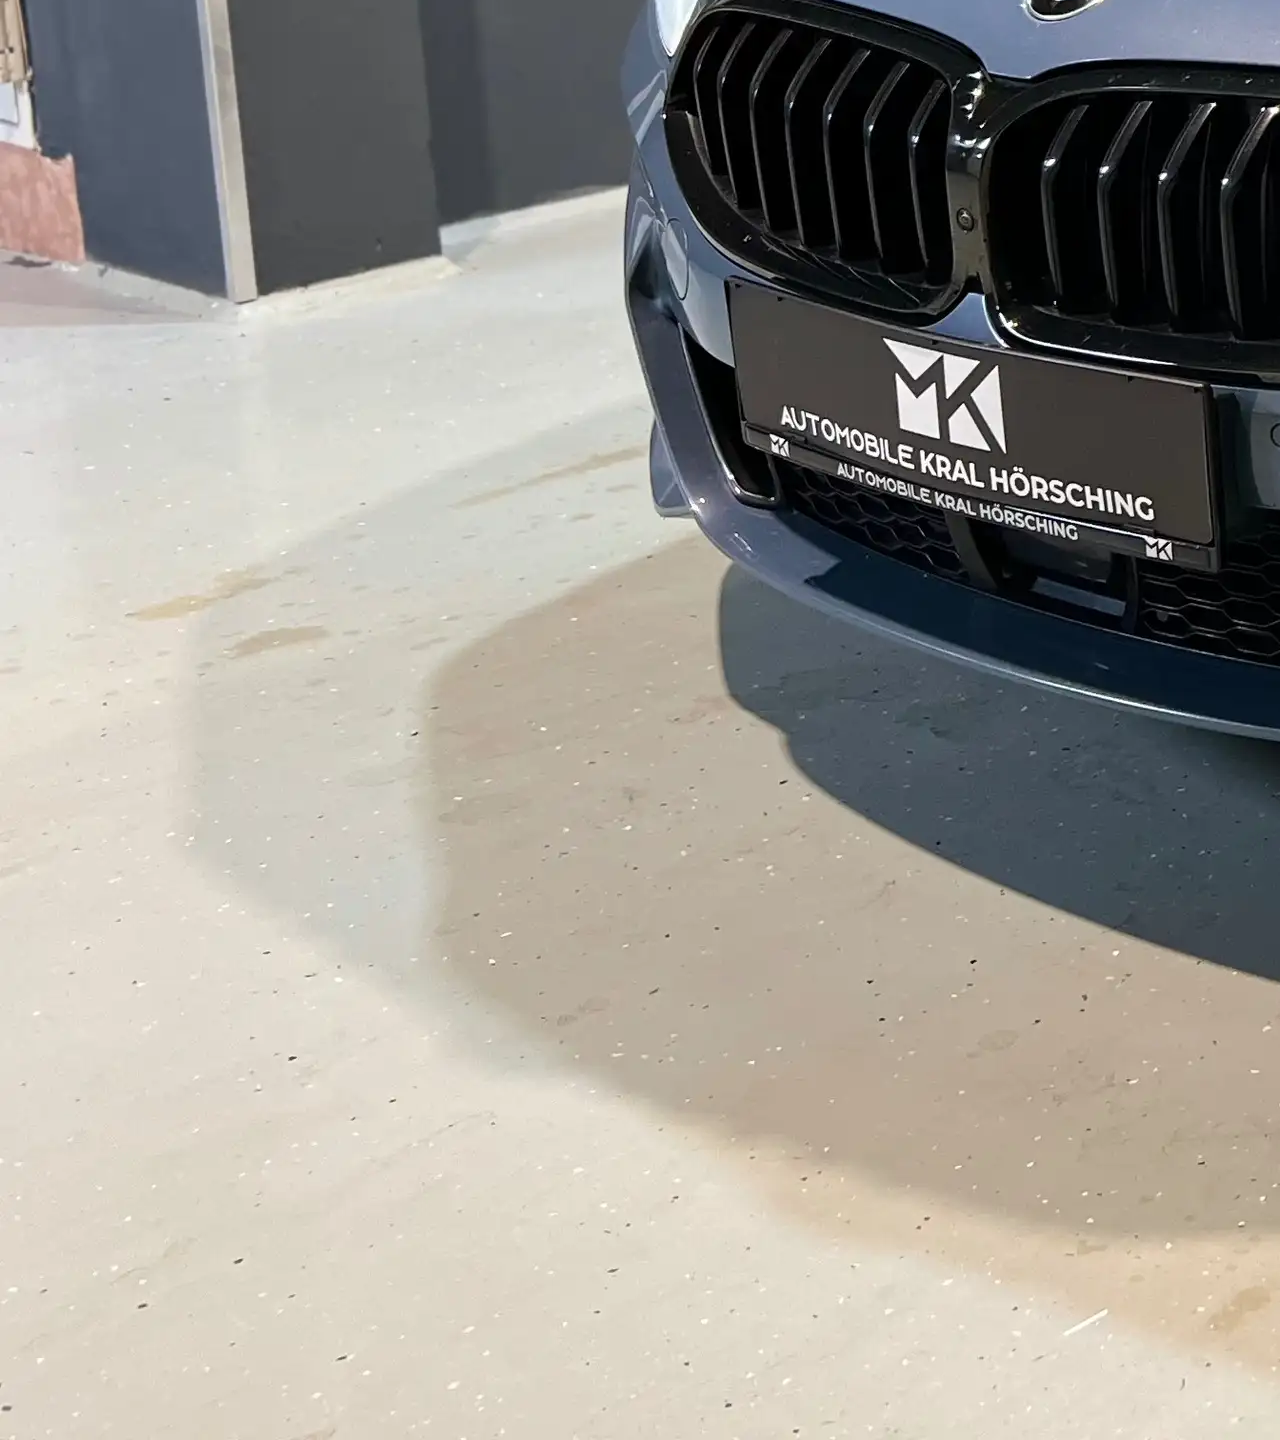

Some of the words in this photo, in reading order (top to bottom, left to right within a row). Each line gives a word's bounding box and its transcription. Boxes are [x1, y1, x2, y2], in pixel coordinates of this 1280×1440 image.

[780, 405, 915, 470] AUTOMOBILE
[919, 449, 985, 488] KRAL
[989, 466, 1156, 521] HÖRSCHING
[836, 462, 932, 504] AUTOMOBILE
[934, 492, 977, 517] KRAL
[979, 503, 1079, 541] HÖRSCHING
